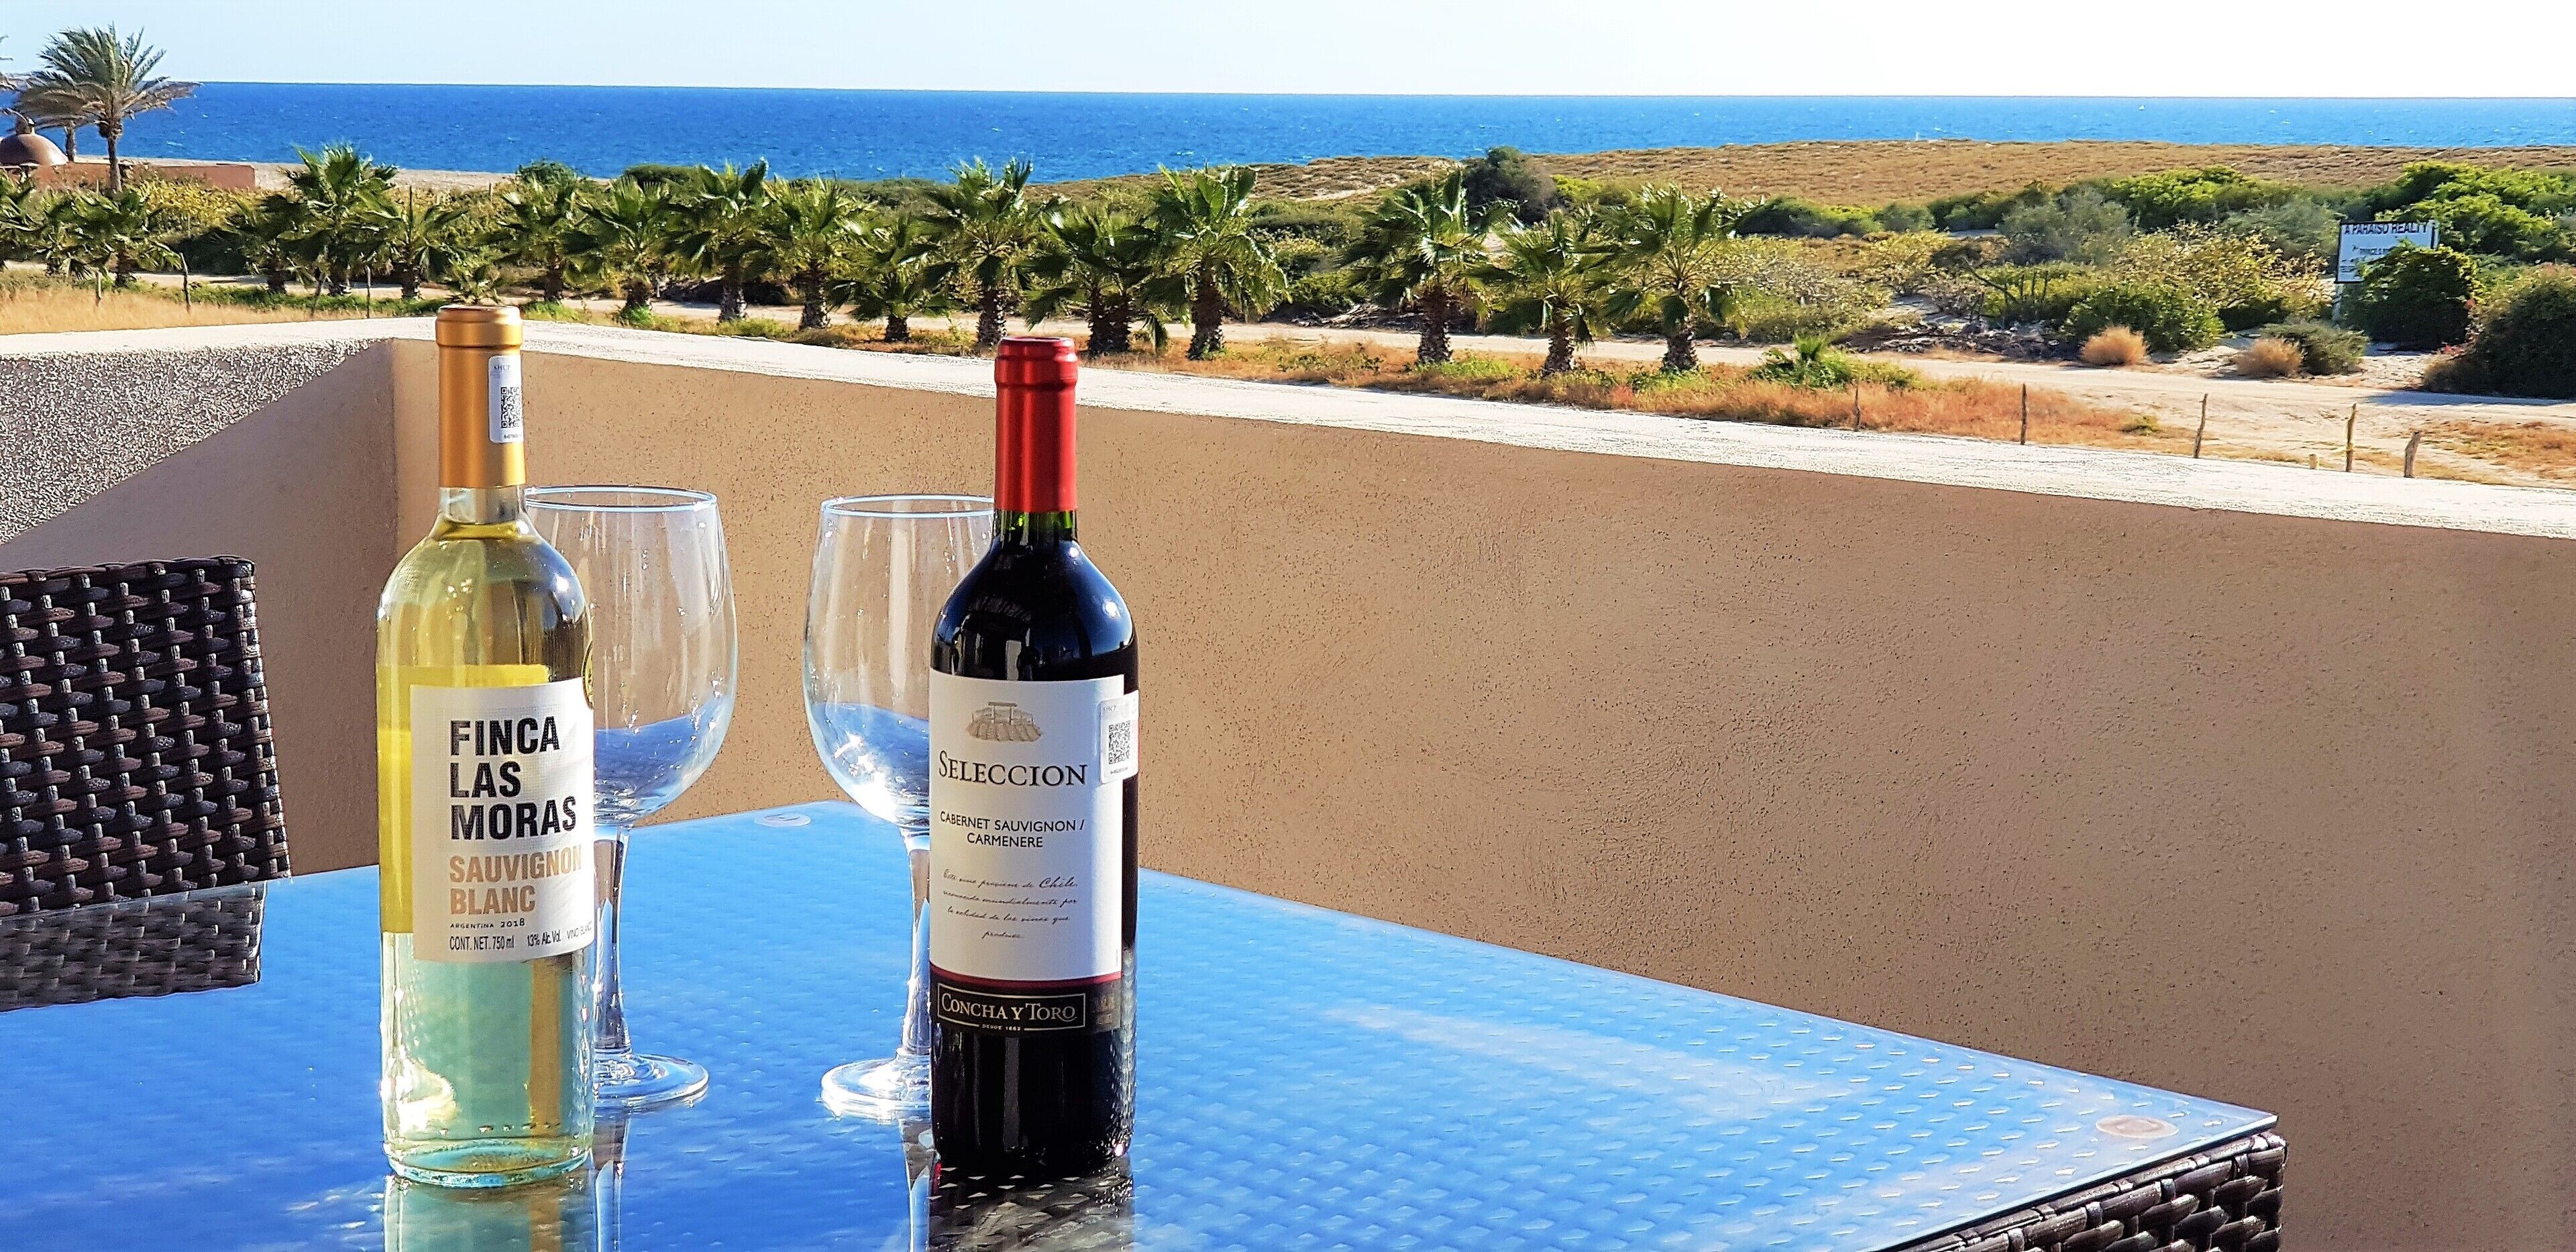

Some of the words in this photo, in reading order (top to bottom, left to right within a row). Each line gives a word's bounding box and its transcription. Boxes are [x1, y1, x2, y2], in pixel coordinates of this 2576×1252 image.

[2392, 221, 2427, 234] REALTY
[450, 716, 560, 756] FINCA
[450, 762, 521, 798] LAS
[938, 750, 1088, 786] SELECCION
[451, 796, 576, 840] MORAS
[940, 811, 990, 831] CABERNET
[994, 819, 1076, 833] SAUVIGNON
[1079, 819, 1085, 831] /
[967, 832, 1044, 848] CARMENERE
[449, 843, 582, 883] SAUVIGNON
[450, 886, 536, 915] BLANC
[1059, 898, 1077, 908] por
[500, 918, 525, 927] 2018
[1053, 915, 1069, 925] que
[449, 936, 472, 951] CONT.
[474, 935, 491, 950] NET.
[492, 935, 505, 950] 750
[527, 934, 540, 947] 13%
[941, 993, 1008, 1021] CONCHA
[1025, 1002, 1077, 1023] TORO
